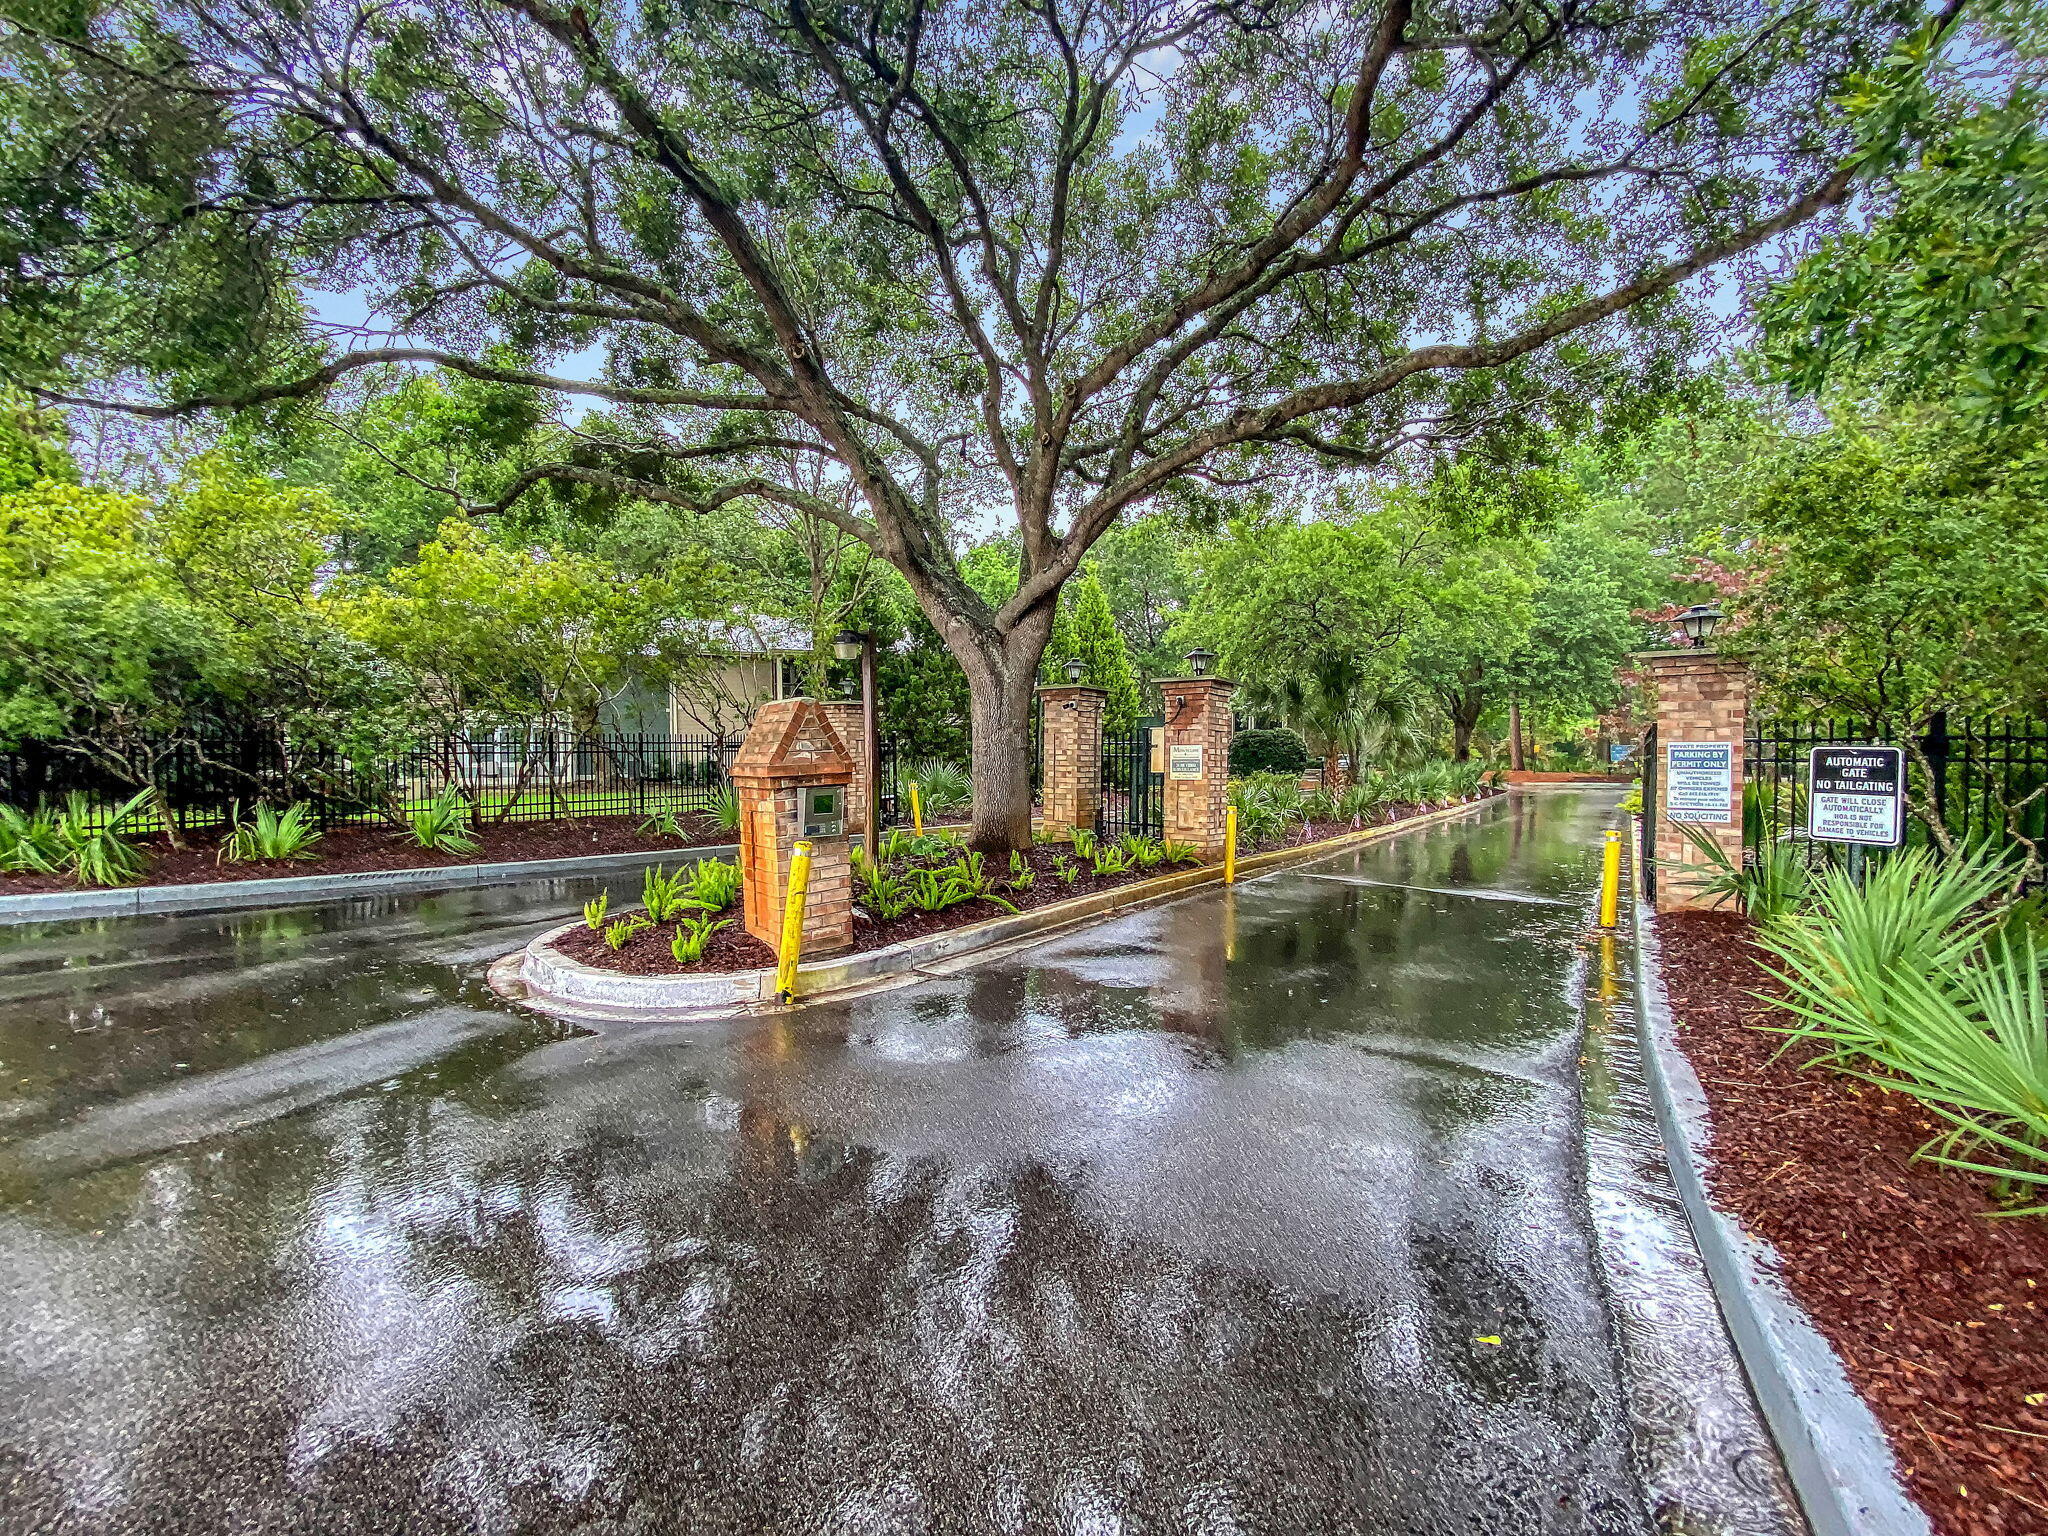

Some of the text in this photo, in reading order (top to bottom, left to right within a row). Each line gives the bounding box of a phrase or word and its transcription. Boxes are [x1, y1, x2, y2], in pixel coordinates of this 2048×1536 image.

[1826, 756, 1884, 767] AUTOMATIC
[1841, 768, 1868, 778] GATE
[1816, 779, 1894, 792] NO TAILGATING
[1820, 796, 1887, 807] GATE WILL CLOSE
[1823, 804, 1884, 814] AUTOMATICALLY
[1823, 819, 1884, 830] RESPONSIBLE FOR
[1817, 826, 1889, 838] DAMAGE TO VEHICLES
